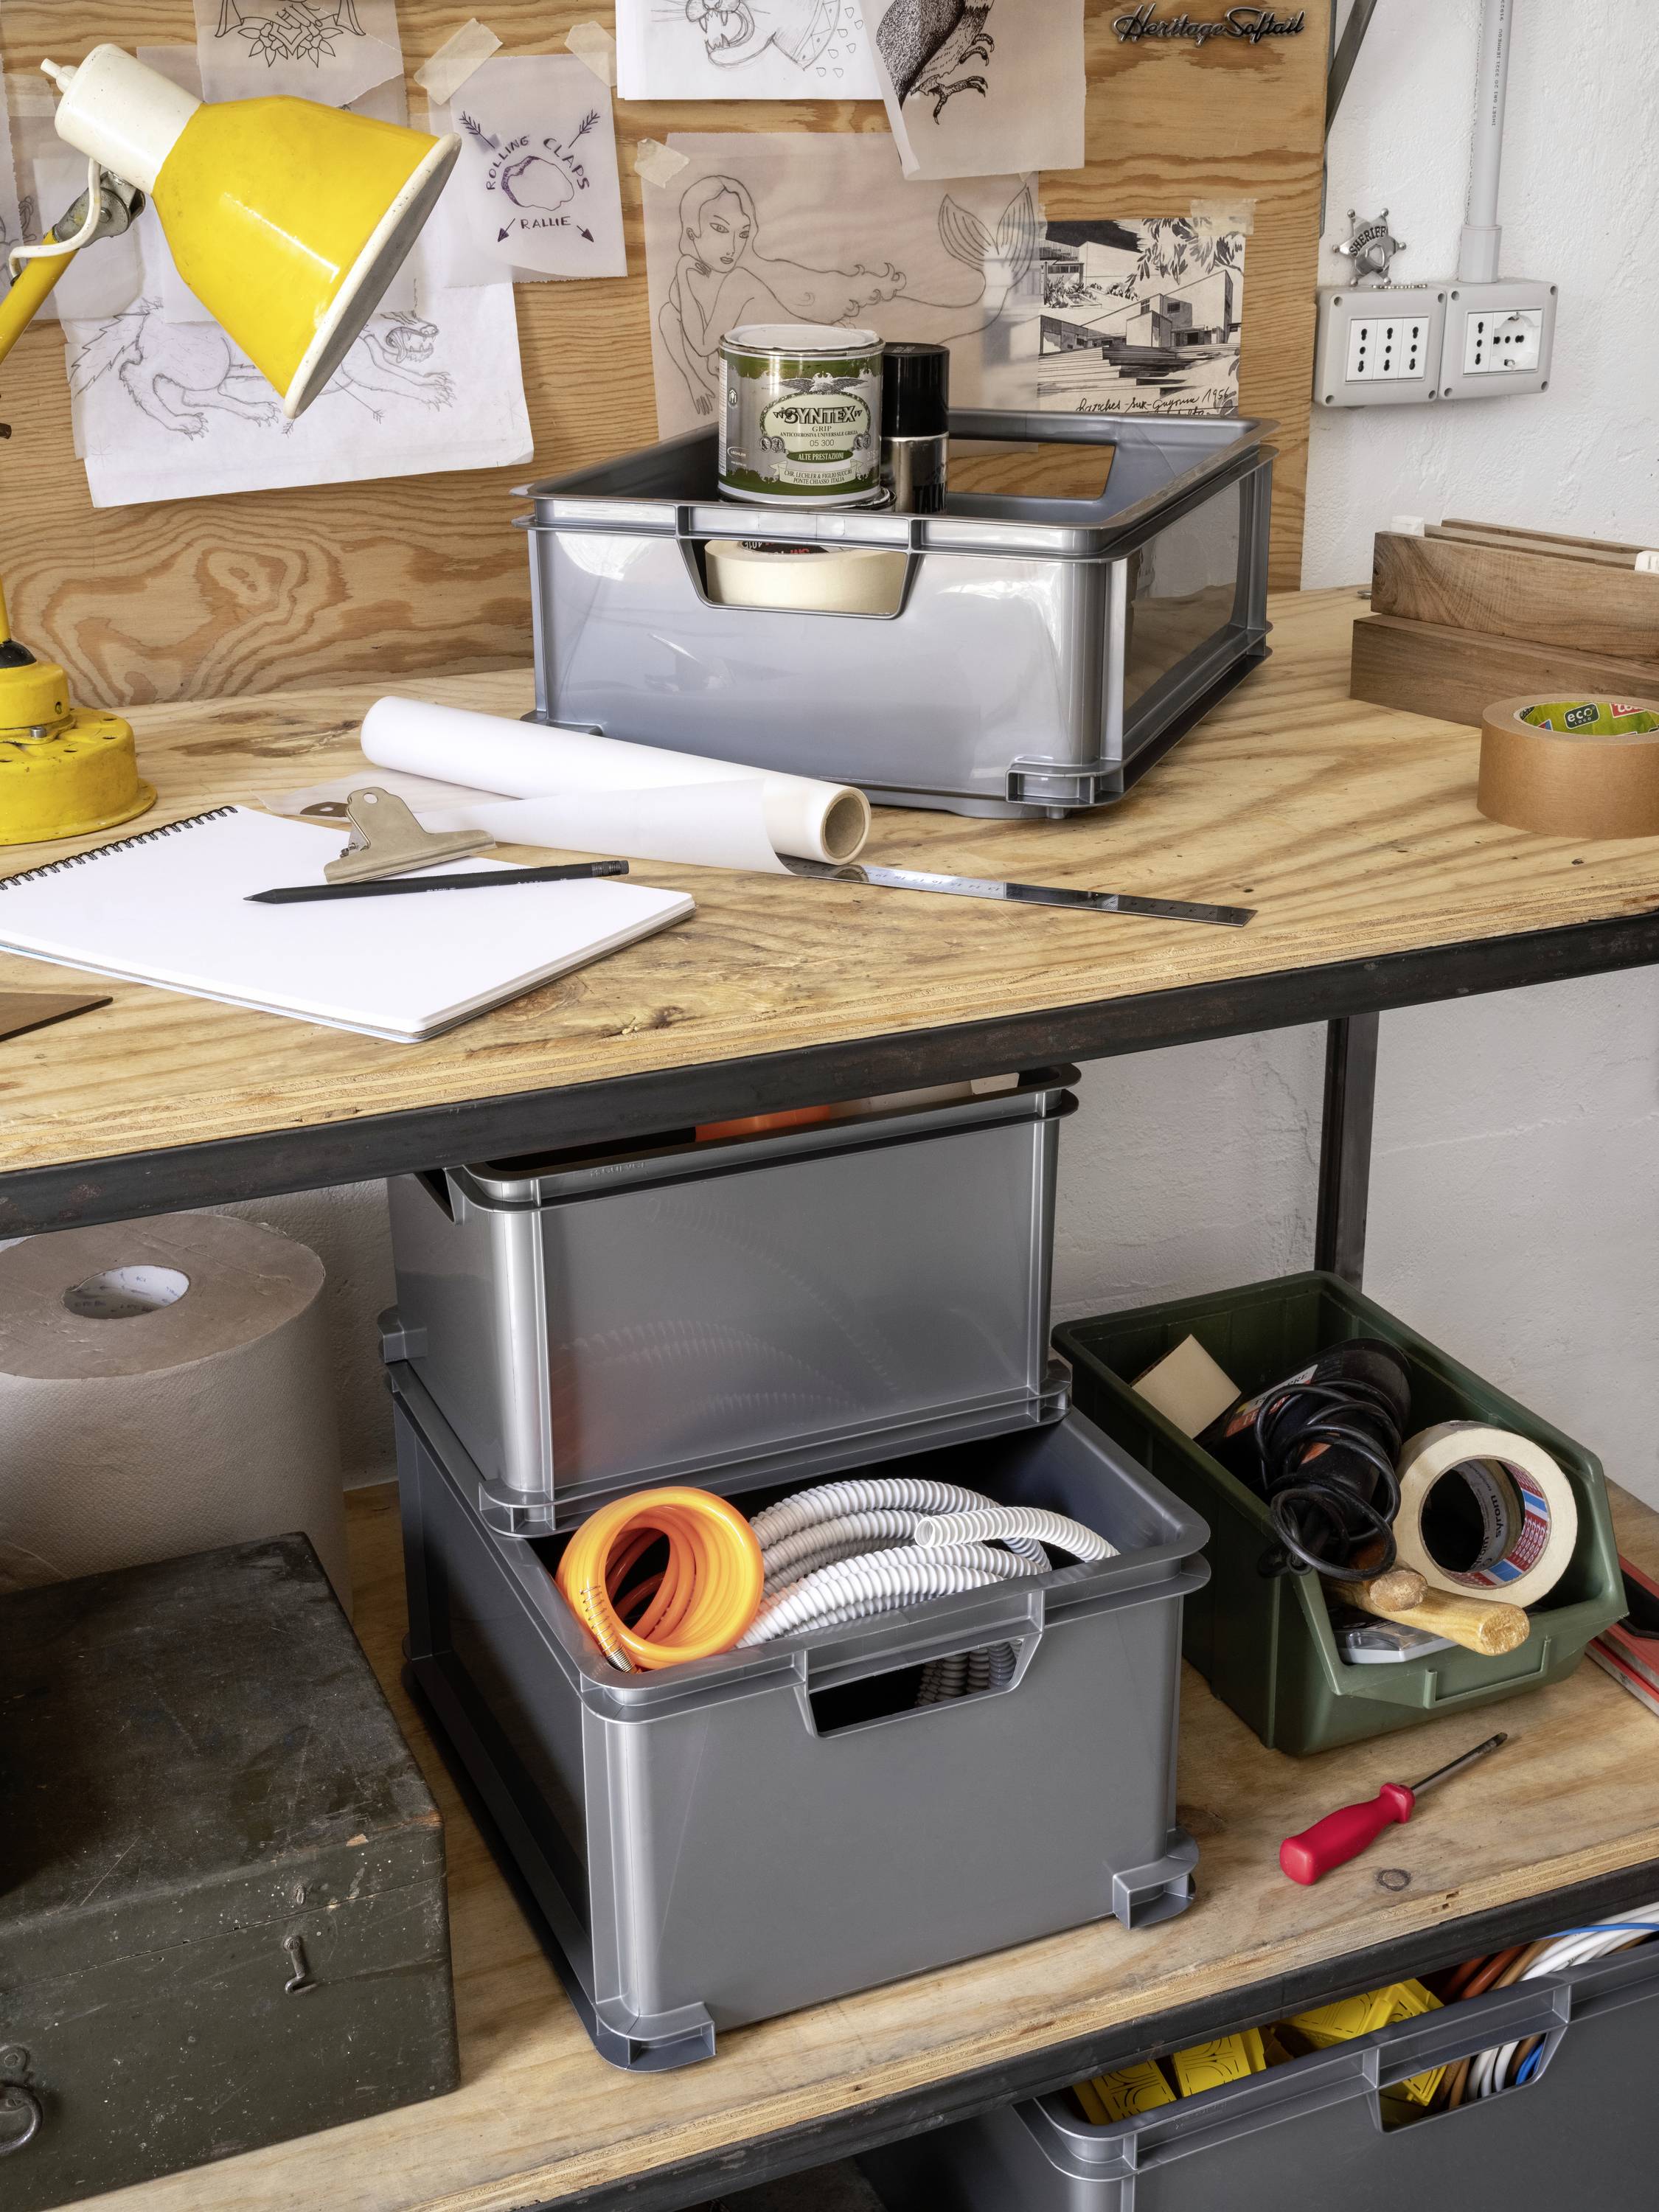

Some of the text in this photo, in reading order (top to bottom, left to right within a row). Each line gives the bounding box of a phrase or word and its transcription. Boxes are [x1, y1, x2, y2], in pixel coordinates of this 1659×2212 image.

[1113, 3, 1306, 47] Heritage Softail
[486, 134, 590, 190] ROLLING CLAPS
[521, 216, 571, 229] RALLIE
[1349, 226, 1386, 256] SHERIFF
[783, 406, 856, 424] SYNTEX
[798, 452, 844, 461] ALTE PRESTAZIONI
[1567, 708, 1593, 722] eco
[1574, 717, 1591, 726] LOGO
[1491, 1495, 1504, 1538] syrom
